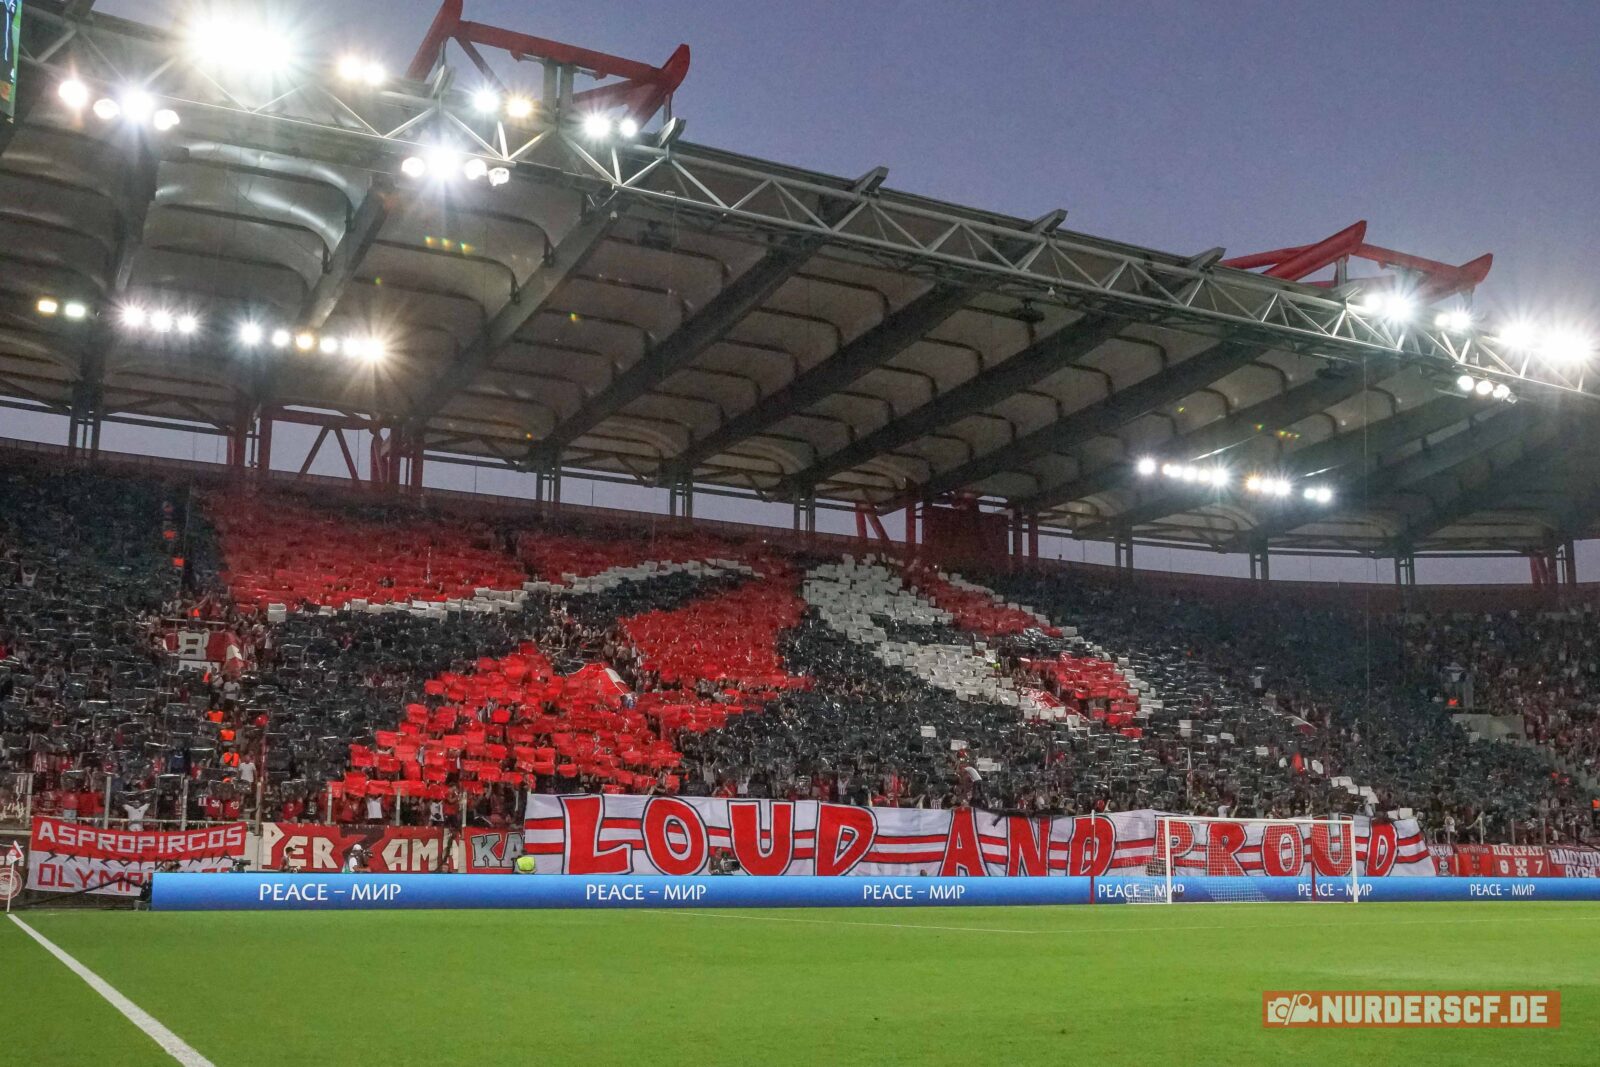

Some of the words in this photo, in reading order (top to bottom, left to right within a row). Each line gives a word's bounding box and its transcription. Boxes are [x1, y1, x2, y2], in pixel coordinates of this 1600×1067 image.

[558, 793, 879, 876] LOUD
[937, 806, 1117, 877] AND
[1154, 814, 1399, 877] PROUD
[259, 884, 328, 900] PEACE
[351, 884, 401, 900] МИР
[586, 884, 643, 900] PEACE
[664, 884, 706, 900] МИР
[863, 885, 912, 900] PEACE
[930, 885, 965, 900] МИР
[1098, 884, 1140, 898] PEACE
[1471, 884, 1501, 896] PEACE
